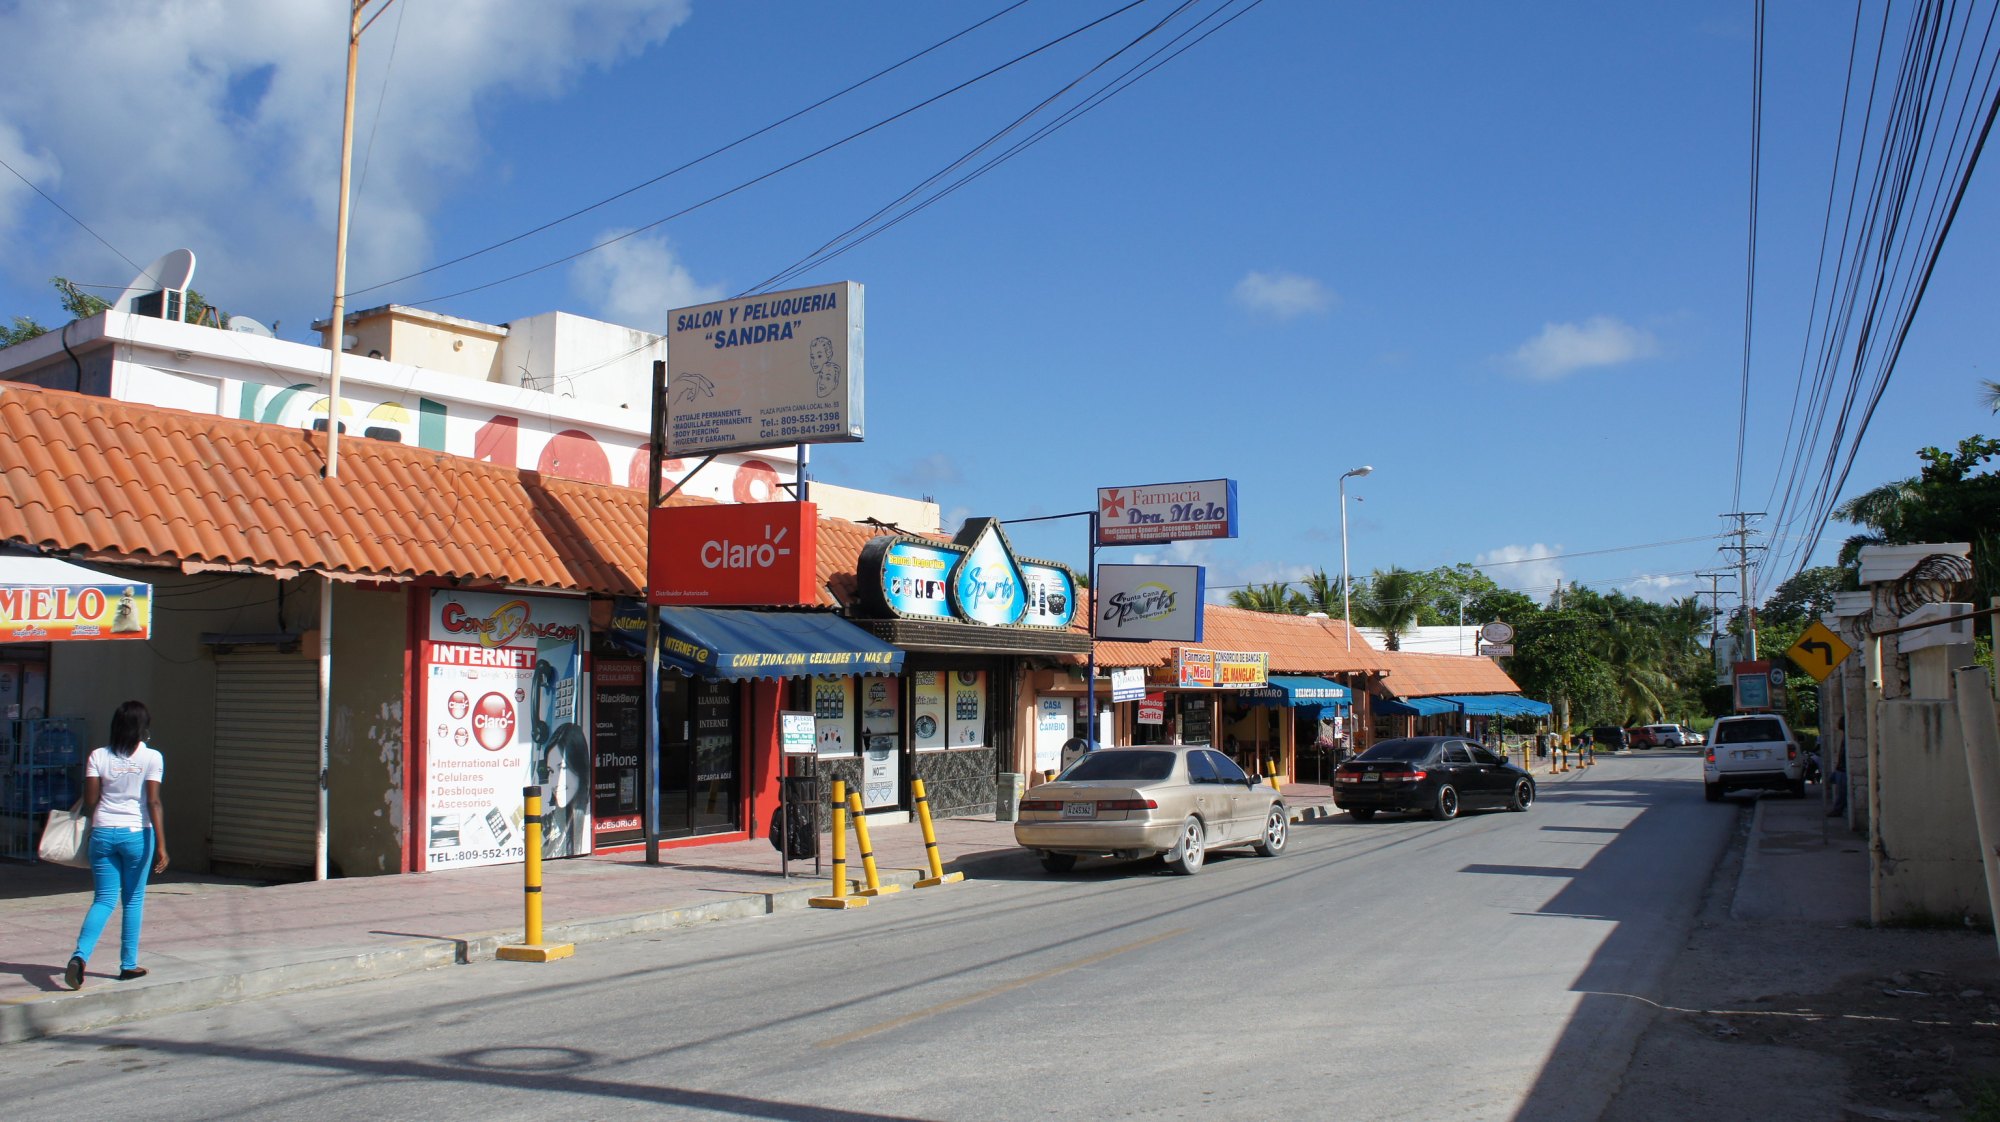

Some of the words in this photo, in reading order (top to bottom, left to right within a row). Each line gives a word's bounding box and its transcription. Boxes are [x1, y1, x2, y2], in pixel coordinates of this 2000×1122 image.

[676, 309, 723, 332] SALON
[729, 306, 739, 324] Y
[743, 292, 837, 322] PELUQUERIA
[701, 408, 742, 418] PERMANENTE
[760, 407, 775, 415] PLAZA
[776, 405, 791, 414] PUNTA
[792, 404, 806, 412] CANA
[806, 402, 823, 411] LOCAL
[712, 416, 753, 426] PERMANENTE
[761, 417, 779, 427] Tel.:
[781, 411, 840, 426] 809-552-1398
[691, 427, 720, 436] PIERCING
[760, 428, 779, 439] Cel.:
[781, 423, 841, 436] 809-841-2991
[705, 434, 736, 442] GARANTIA
[1132, 485, 1201, 505] Farmacia
[1127, 507, 1164, 524] Dra.
[1170, 502, 1225, 522] Melo
[701, 538, 776, 568] Claro
[888, 554, 911, 566] Banca
[912, 556, 945, 569] Deportiva
[0, 588, 106, 621] MELO
[1103, 589, 1178, 628] Sports
[432, 644, 536, 668] INTERNET
[809, 652, 851, 664] CELULARES
[855, 651, 861, 662] Y
[864, 651, 882, 663] MAS
[1184, 650, 1211, 662] Farmacia
[1215, 652, 1239, 662] CONSORCIO
[1240, 653, 1245, 662] DE
[1246, 653, 1261, 662] BANCAS
[1193, 666, 1211, 679] Melo
[1223, 667, 1229, 682] EL
[1230, 667, 1256, 682] MANGLAR
[600, 693, 640, 704] BlackBerry
[1239, 688, 1250, 697] DE
[1253, 688, 1283, 698] BAVARO
[1295, 688, 1317, 698] DELICIAS
[1317, 688, 1324, 698] DE
[1043, 700, 1061, 710] CASA
[1048, 712, 1057, 720] DE
[1138, 710, 1162, 720] Sarita
[474, 714, 509, 729] Claro
[699, 719, 729, 728] INTERNET
[1039, 722, 1065, 731] CAMBIO
[437, 758, 500, 769] International
[502, 757, 520, 767] Call
[602, 752, 638, 768] iPhone
[437, 773, 484, 783] Celulares
[697, 772, 720, 782] RECARGA
[437, 786, 495, 797] Desbloqueo
